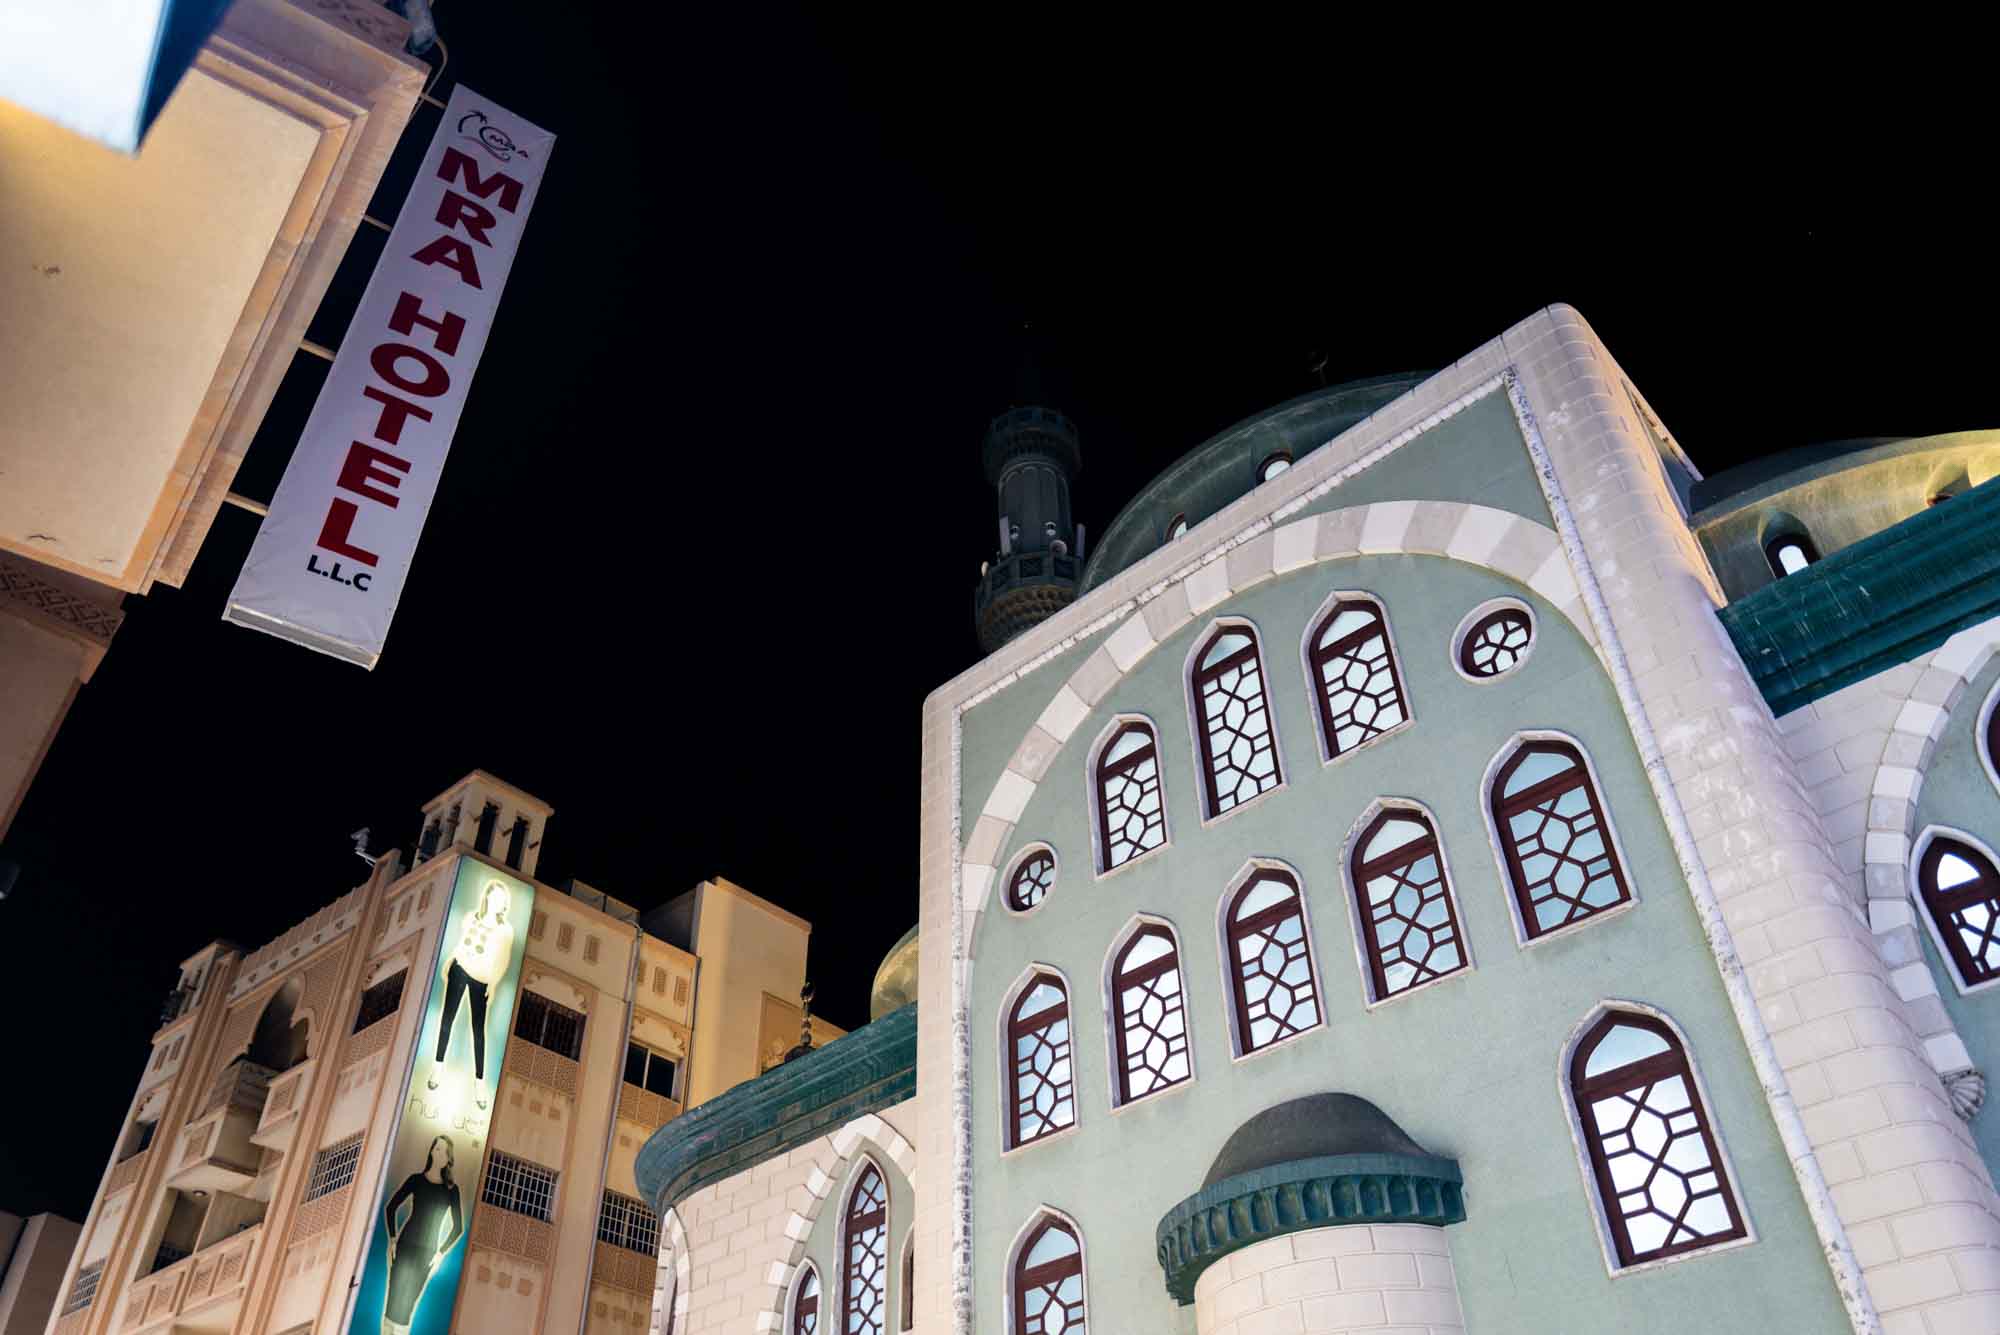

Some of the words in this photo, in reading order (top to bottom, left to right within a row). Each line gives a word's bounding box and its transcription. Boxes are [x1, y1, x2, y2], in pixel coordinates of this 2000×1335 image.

[410, 146, 524, 290] MRA
[316, 291, 467, 568] HOTEL
[306, 554, 372, 592] L.L.C
